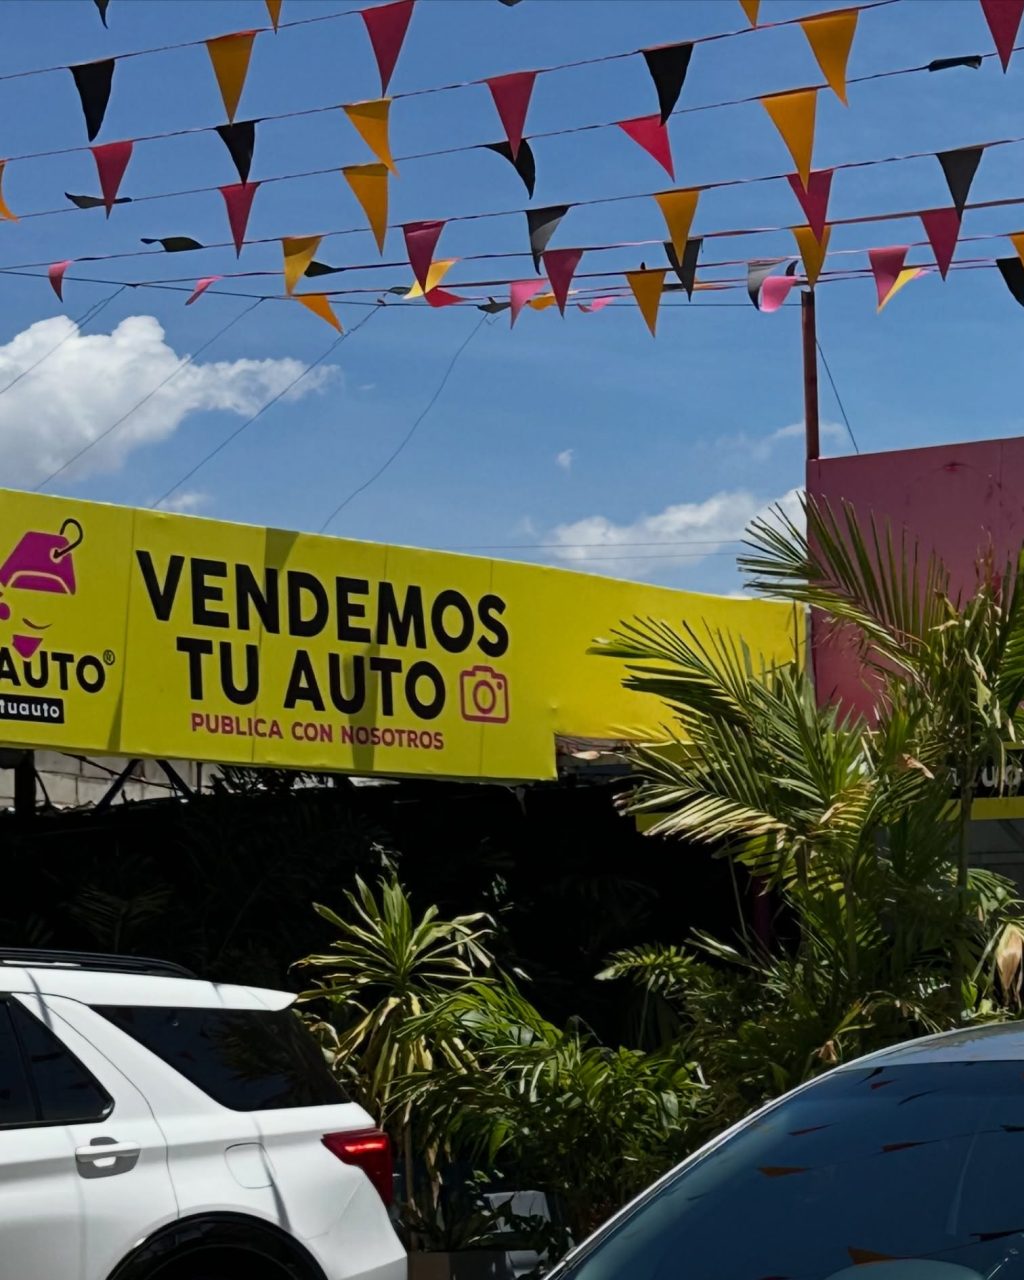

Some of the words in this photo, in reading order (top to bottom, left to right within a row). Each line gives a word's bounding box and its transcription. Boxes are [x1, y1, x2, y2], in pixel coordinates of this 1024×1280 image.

[136, 549, 509, 658] VENDEMOS
[176, 636, 259, 705] TU
[283, 649, 446, 720] AUTO
[191, 712, 283, 739] PUBLICA
[291, 722, 333, 743] CON
[341, 725, 444, 750] NOSOTROS
